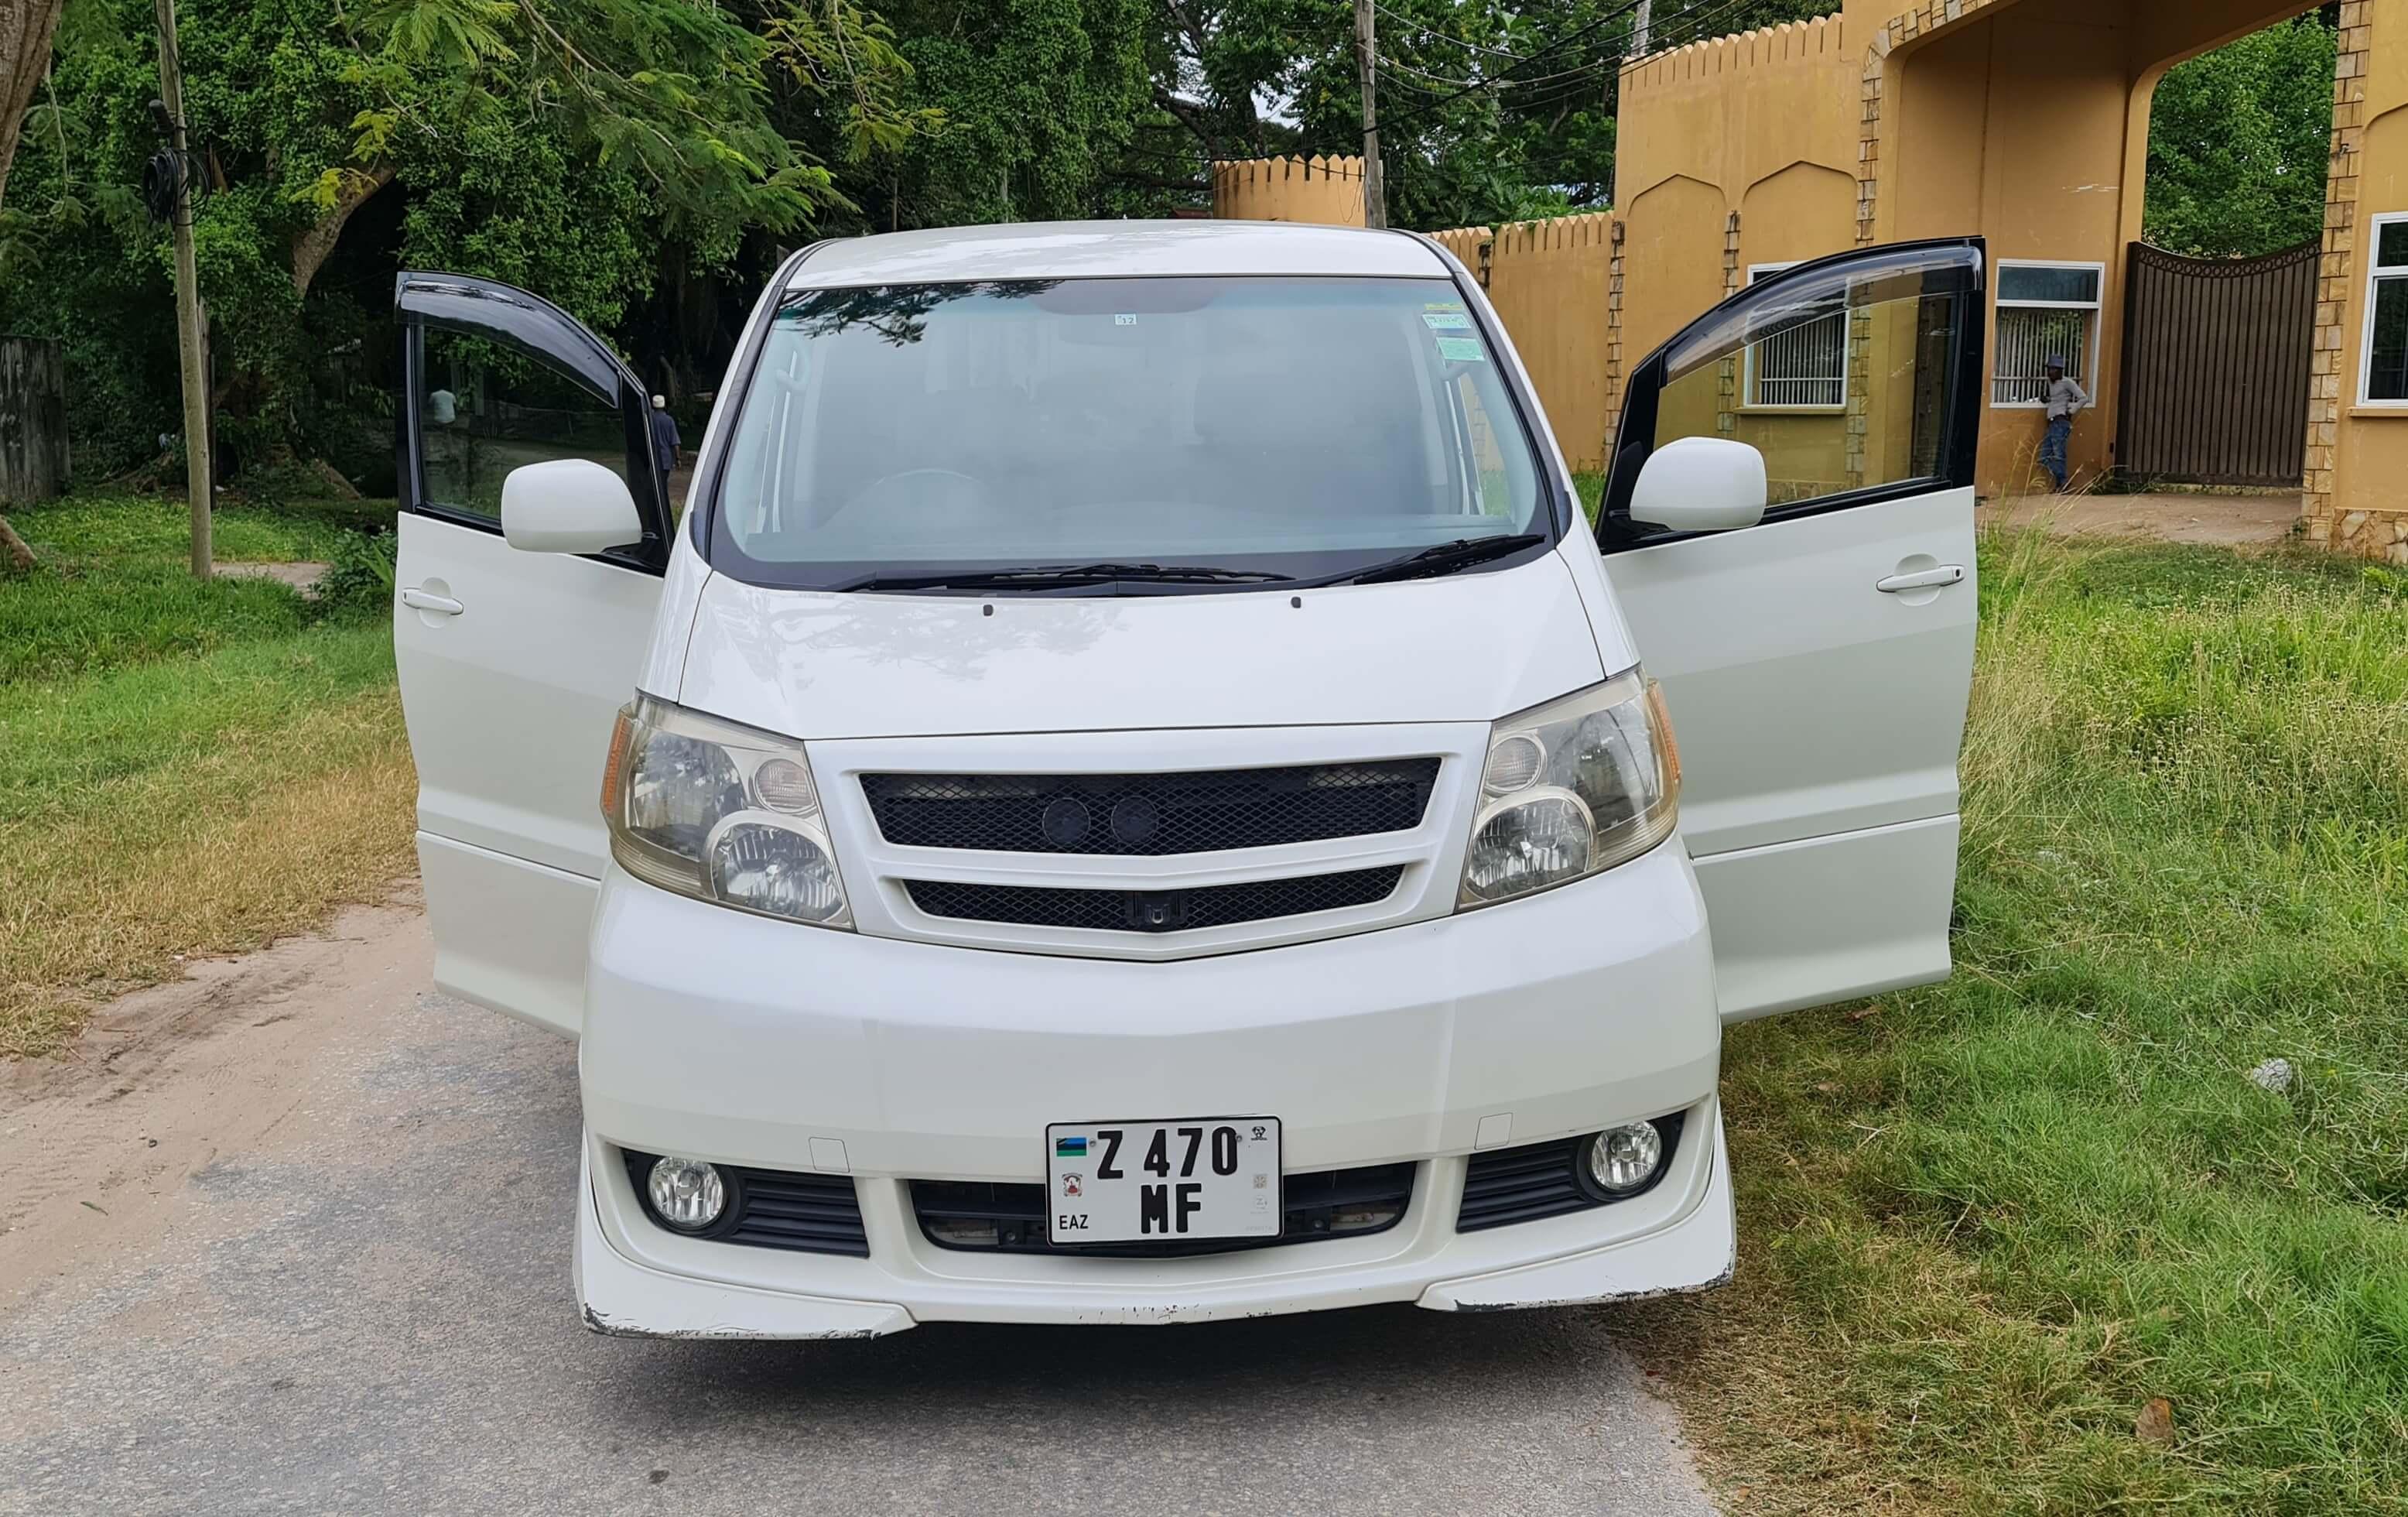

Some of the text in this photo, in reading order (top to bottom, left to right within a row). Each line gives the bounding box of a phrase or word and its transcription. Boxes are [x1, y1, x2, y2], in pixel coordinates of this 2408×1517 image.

[1097, 1126, 1238, 1180] Z 470
[1059, 1214, 1089, 1230] EAZ
[1141, 1183, 1202, 1234] MF
